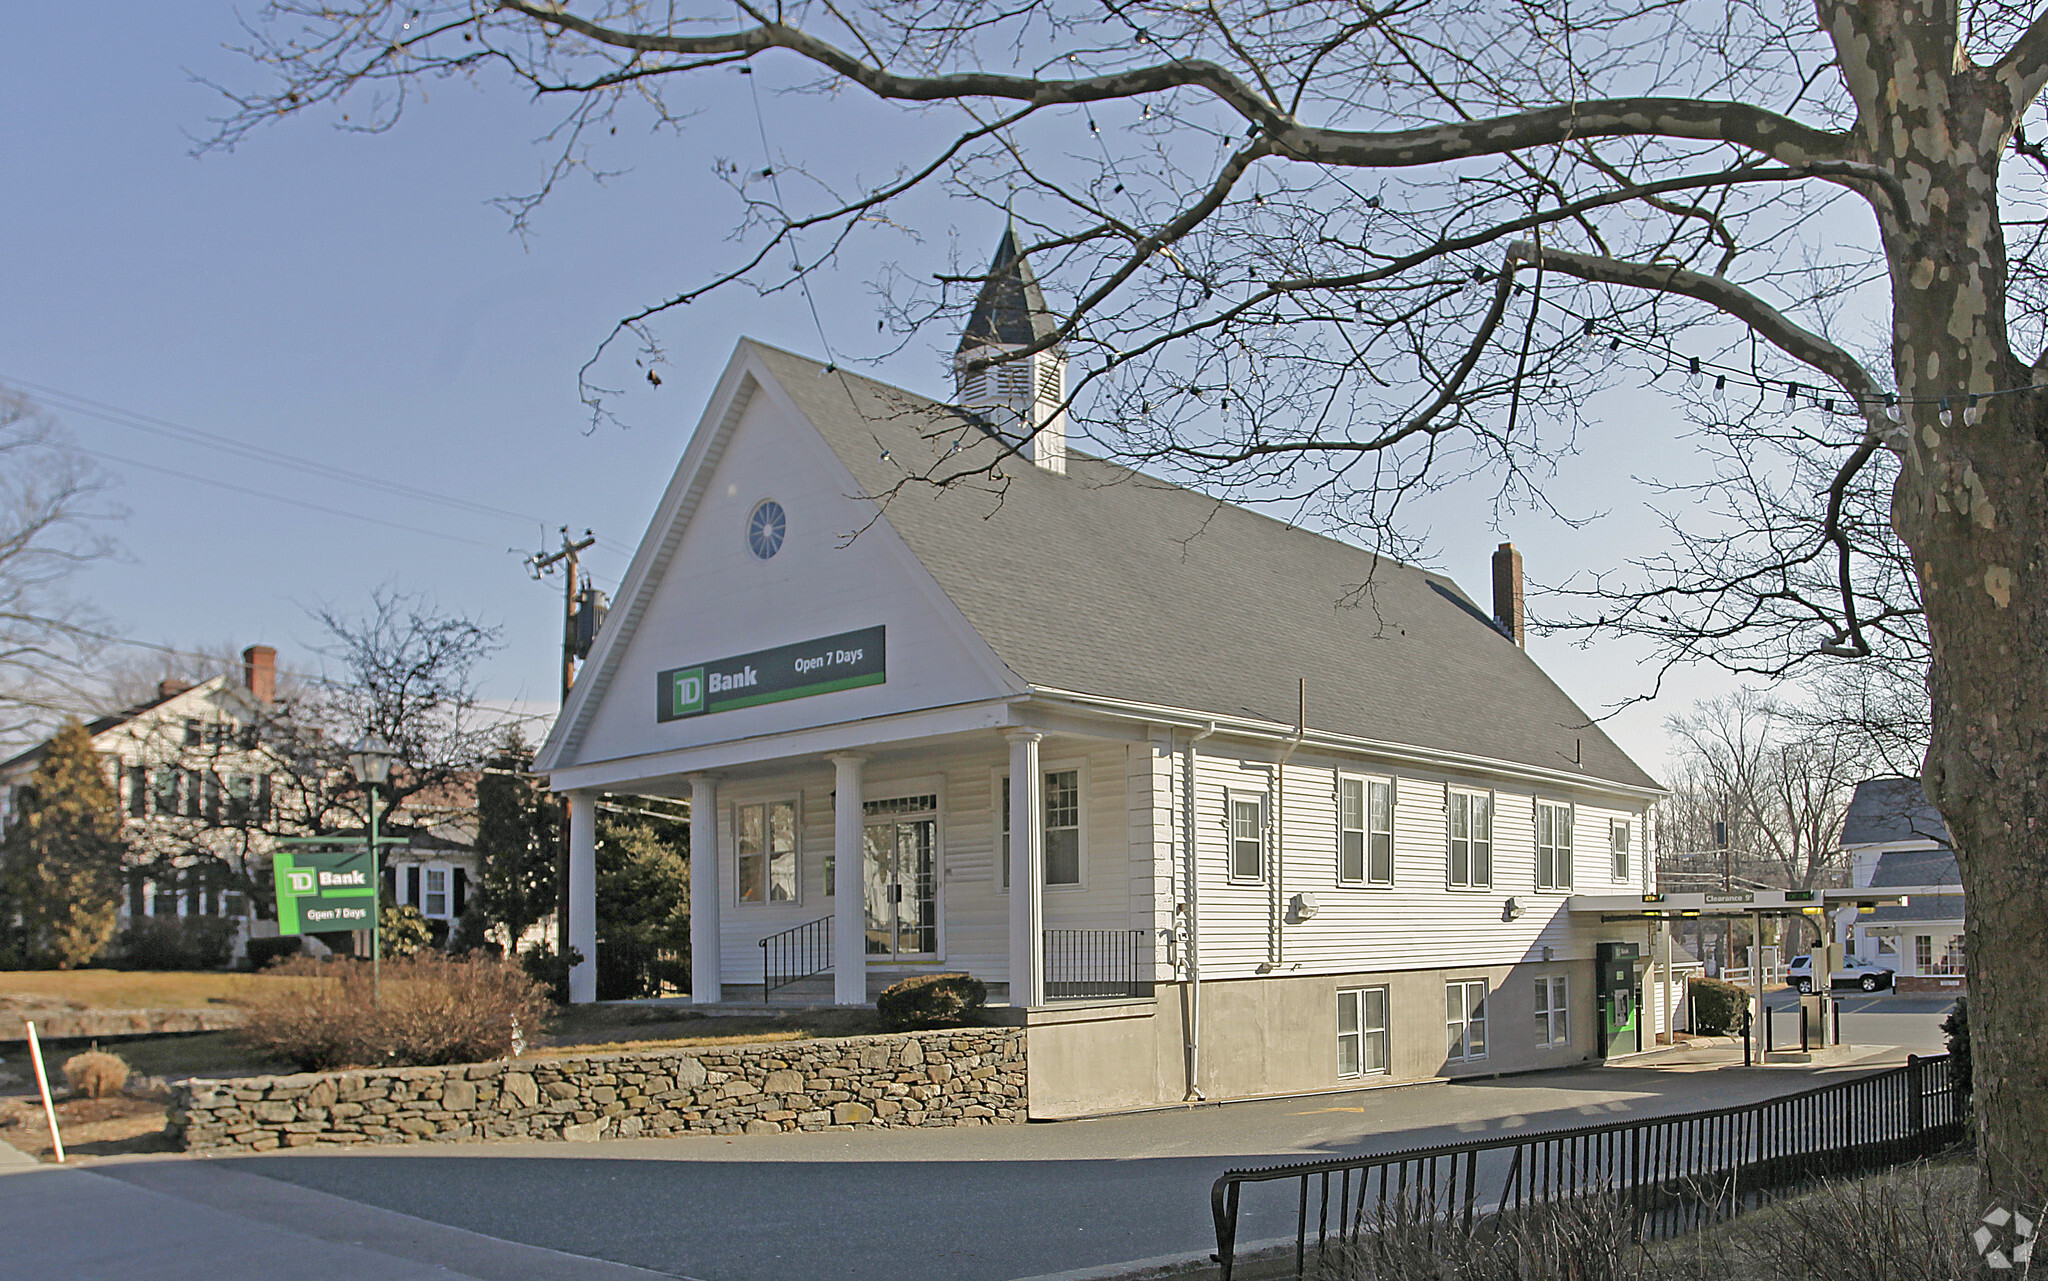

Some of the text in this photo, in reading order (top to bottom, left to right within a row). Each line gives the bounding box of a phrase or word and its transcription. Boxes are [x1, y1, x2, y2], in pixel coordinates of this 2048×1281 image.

[677, 648, 863, 705] TD Bank Open 7 Days
[288, 870, 365, 890] TD Bank
[307, 908, 366, 921] Open 7 Days
